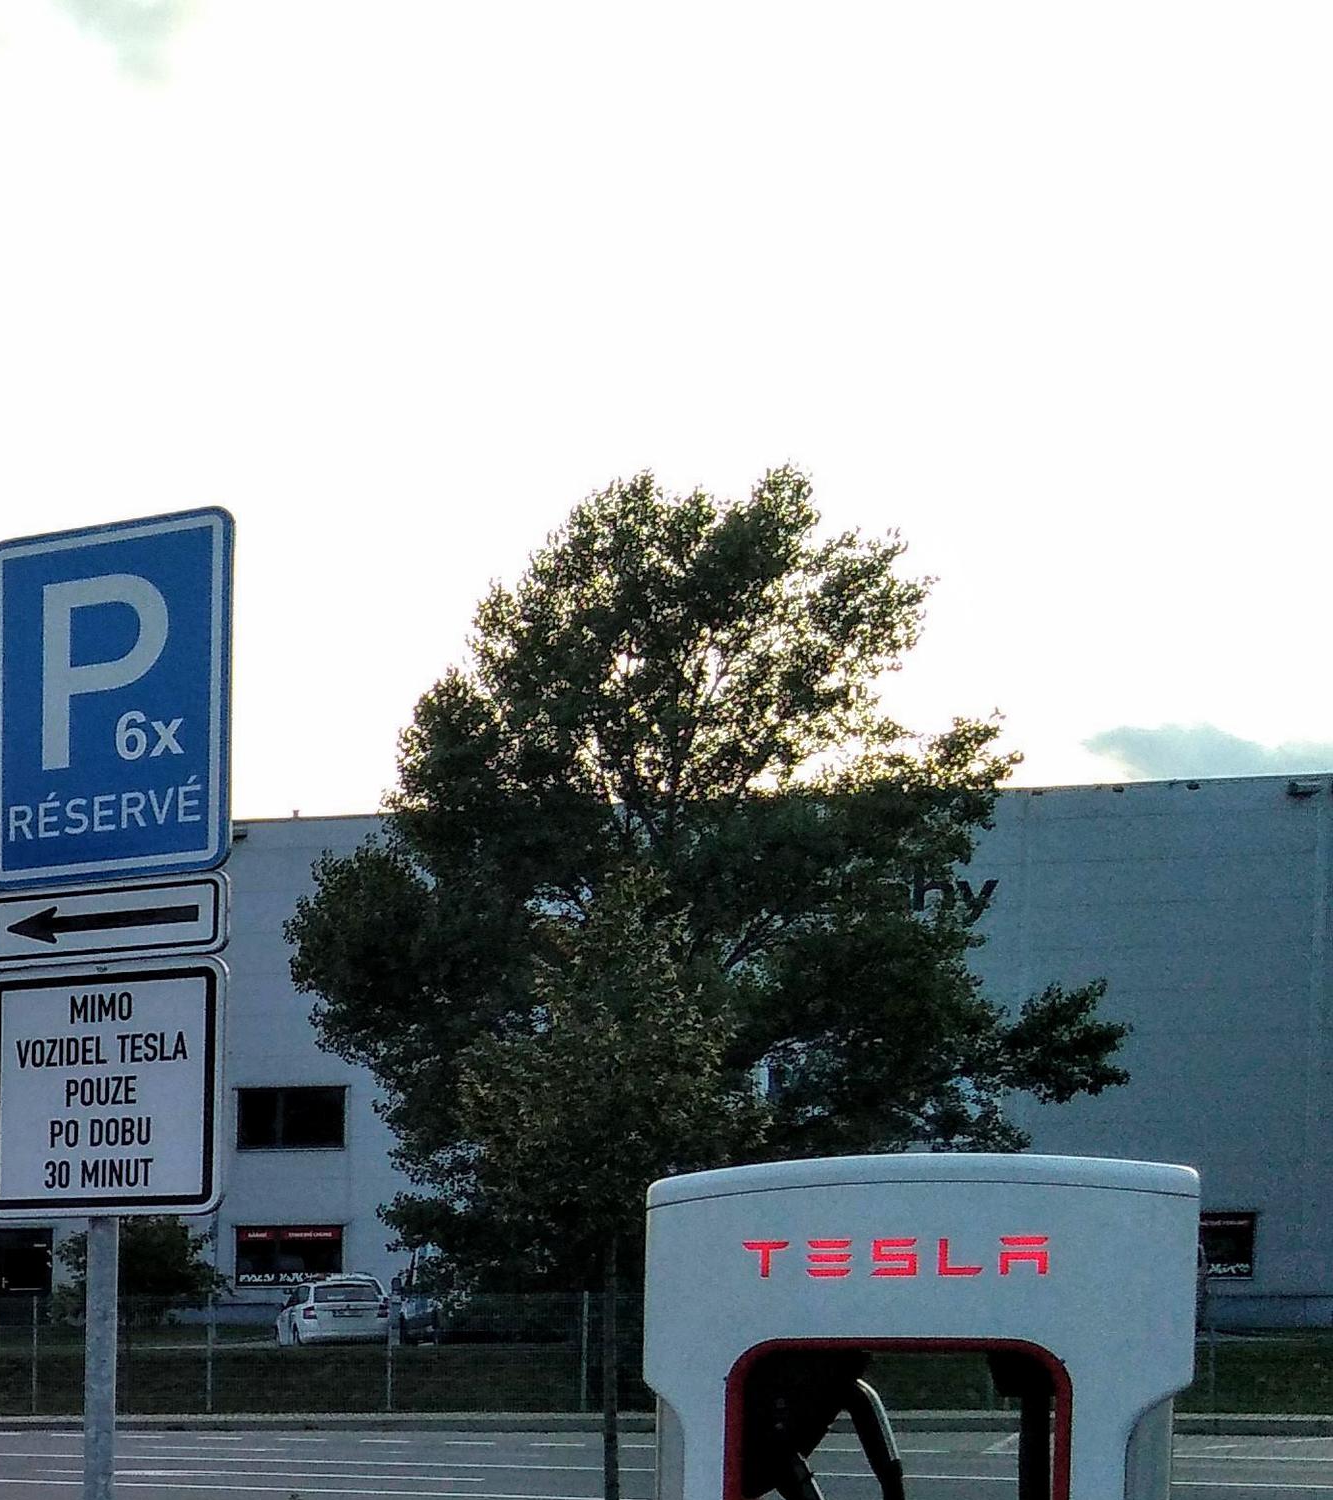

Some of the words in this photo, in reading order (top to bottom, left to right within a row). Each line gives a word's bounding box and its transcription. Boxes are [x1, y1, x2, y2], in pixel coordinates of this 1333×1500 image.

[42, 573, 169, 771] P
[115, 710, 184, 761] 6x
[8, 774, 202, 842] RÉSERVÉ
[69, 991, 133, 1025] MIMO
[16, 1036, 107, 1069] VOZIDEL
[117, 1030, 188, 1063] TESLA
[65, 1075, 137, 1108] POUZE
[49, 1119, 79, 1149] PO
[89, 1116, 151, 1147] DOBU
[44, 1160, 70, 1189] 30
[81, 1158, 154, 1188] MINUT
[743, 1236, 1049, 1278] TESLA
